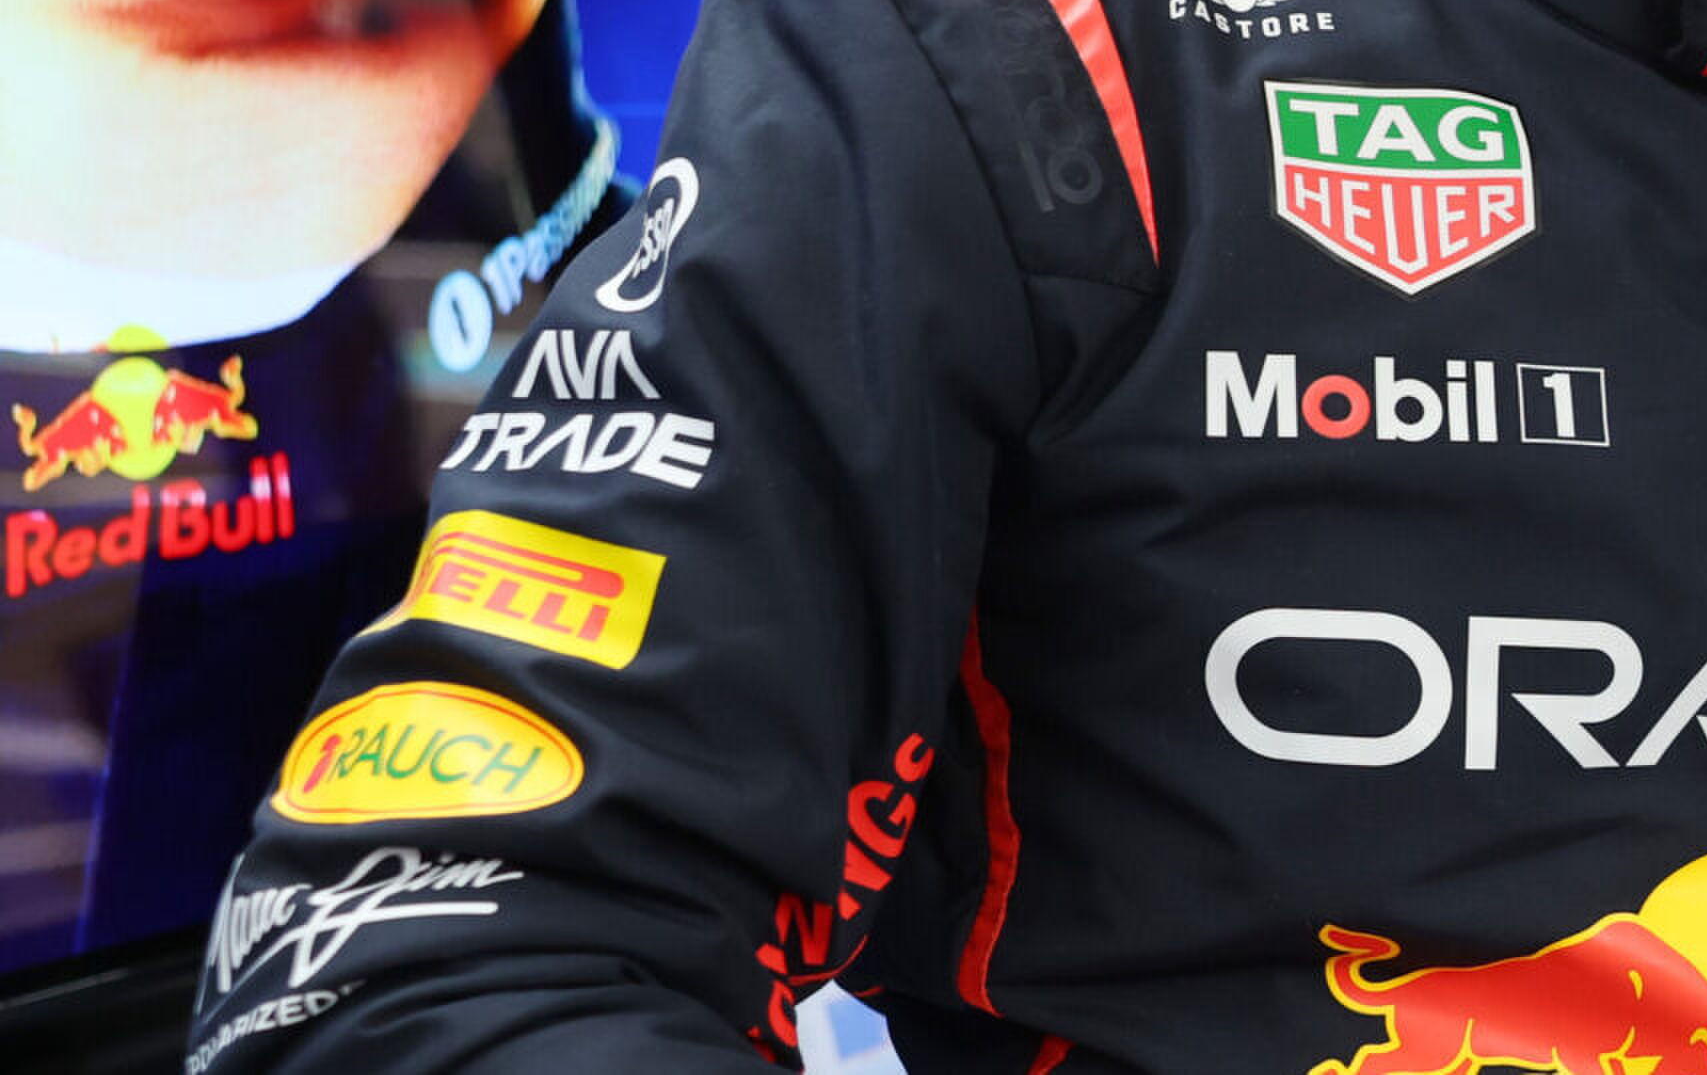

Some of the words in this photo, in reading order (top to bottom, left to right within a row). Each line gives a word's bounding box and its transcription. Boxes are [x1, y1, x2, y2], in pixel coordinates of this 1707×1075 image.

[1288, 99, 1506, 164] TAG
[1294, 171, 1517, 276] HEUER
[1204, 350, 1499, 444] Mobil
[438, 411, 716, 491] TRADE
[5, 483, 152, 600] Red
[157, 449, 296, 562] Bull
[328, 723, 544, 794] RAUCH
